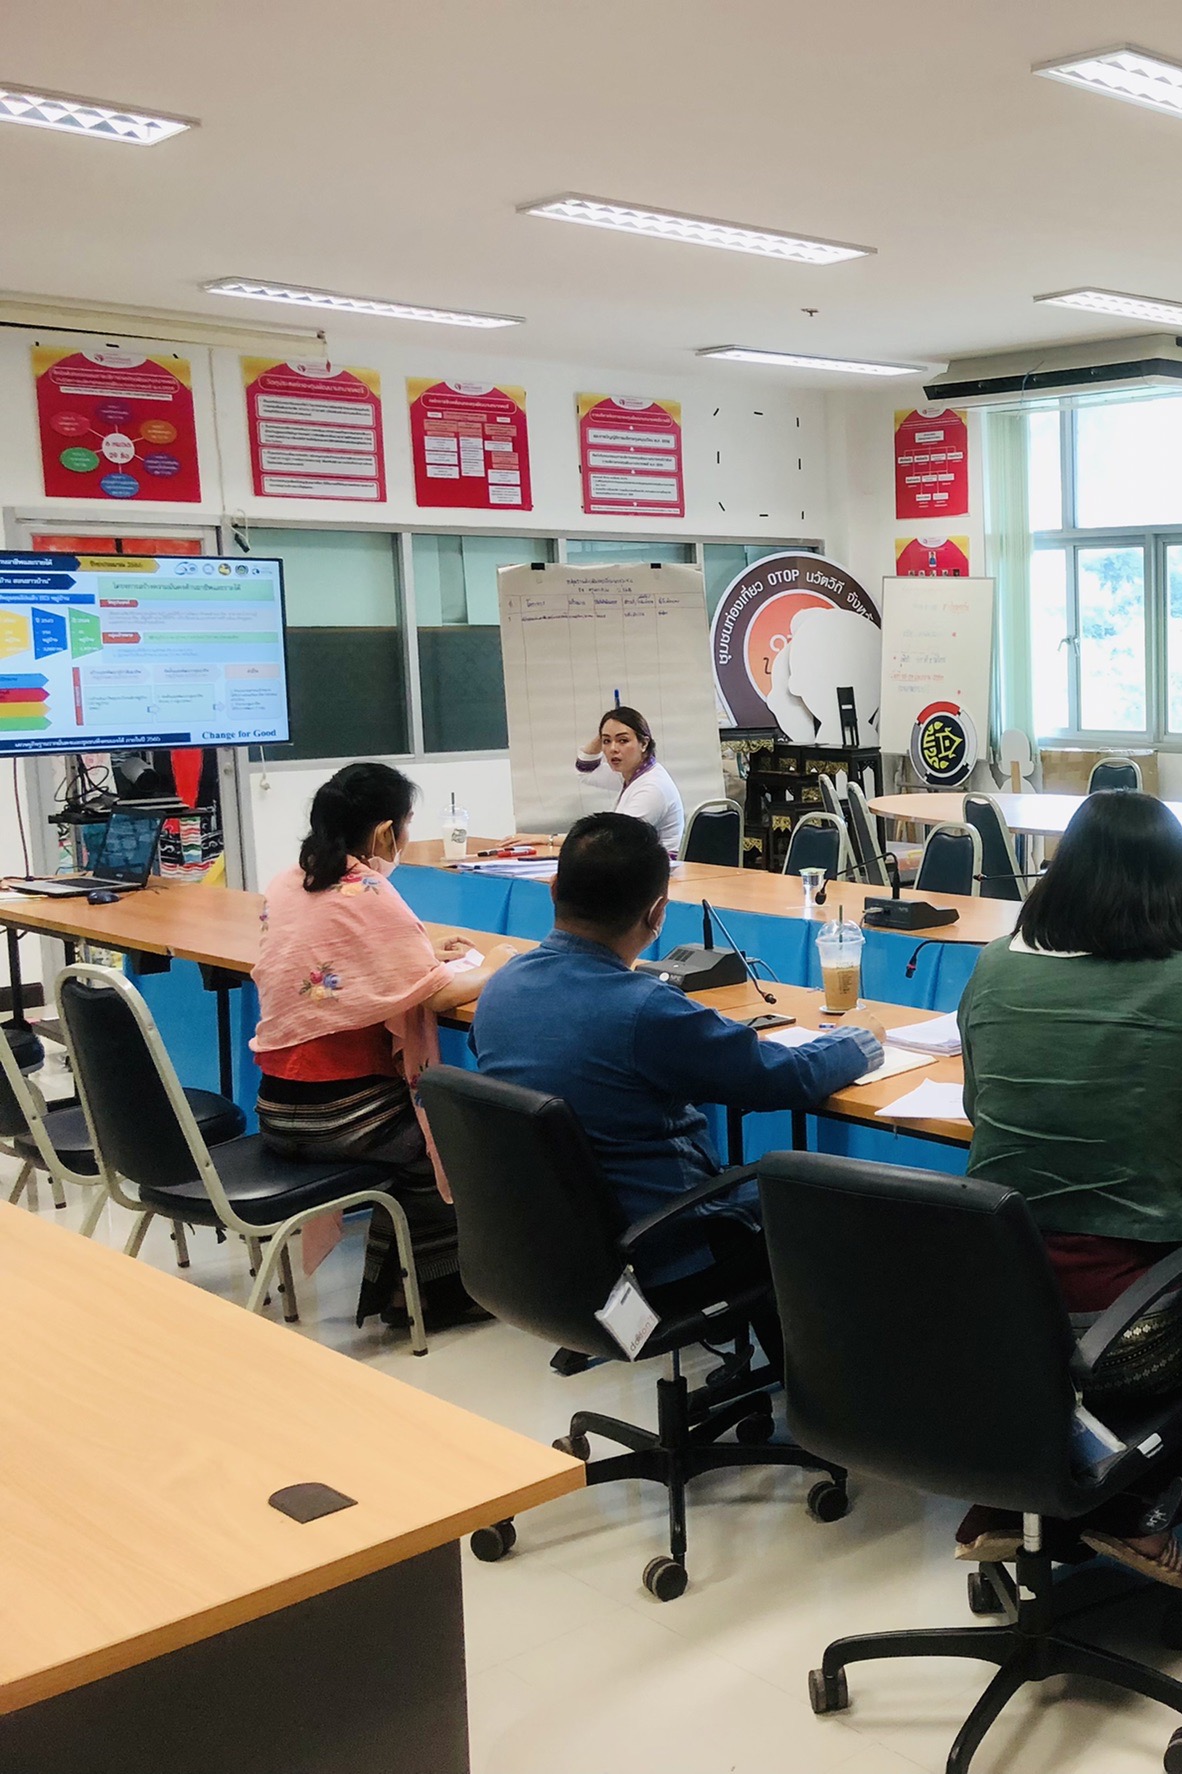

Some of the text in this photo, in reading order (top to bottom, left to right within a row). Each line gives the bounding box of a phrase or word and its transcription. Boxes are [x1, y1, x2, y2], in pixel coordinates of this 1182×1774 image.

[719, 569, 874, 665] ชุมชนท่องเที่ยว OTOP นวัตวิถี จังหวั
[202, 728, 277, 740] Change for Good
